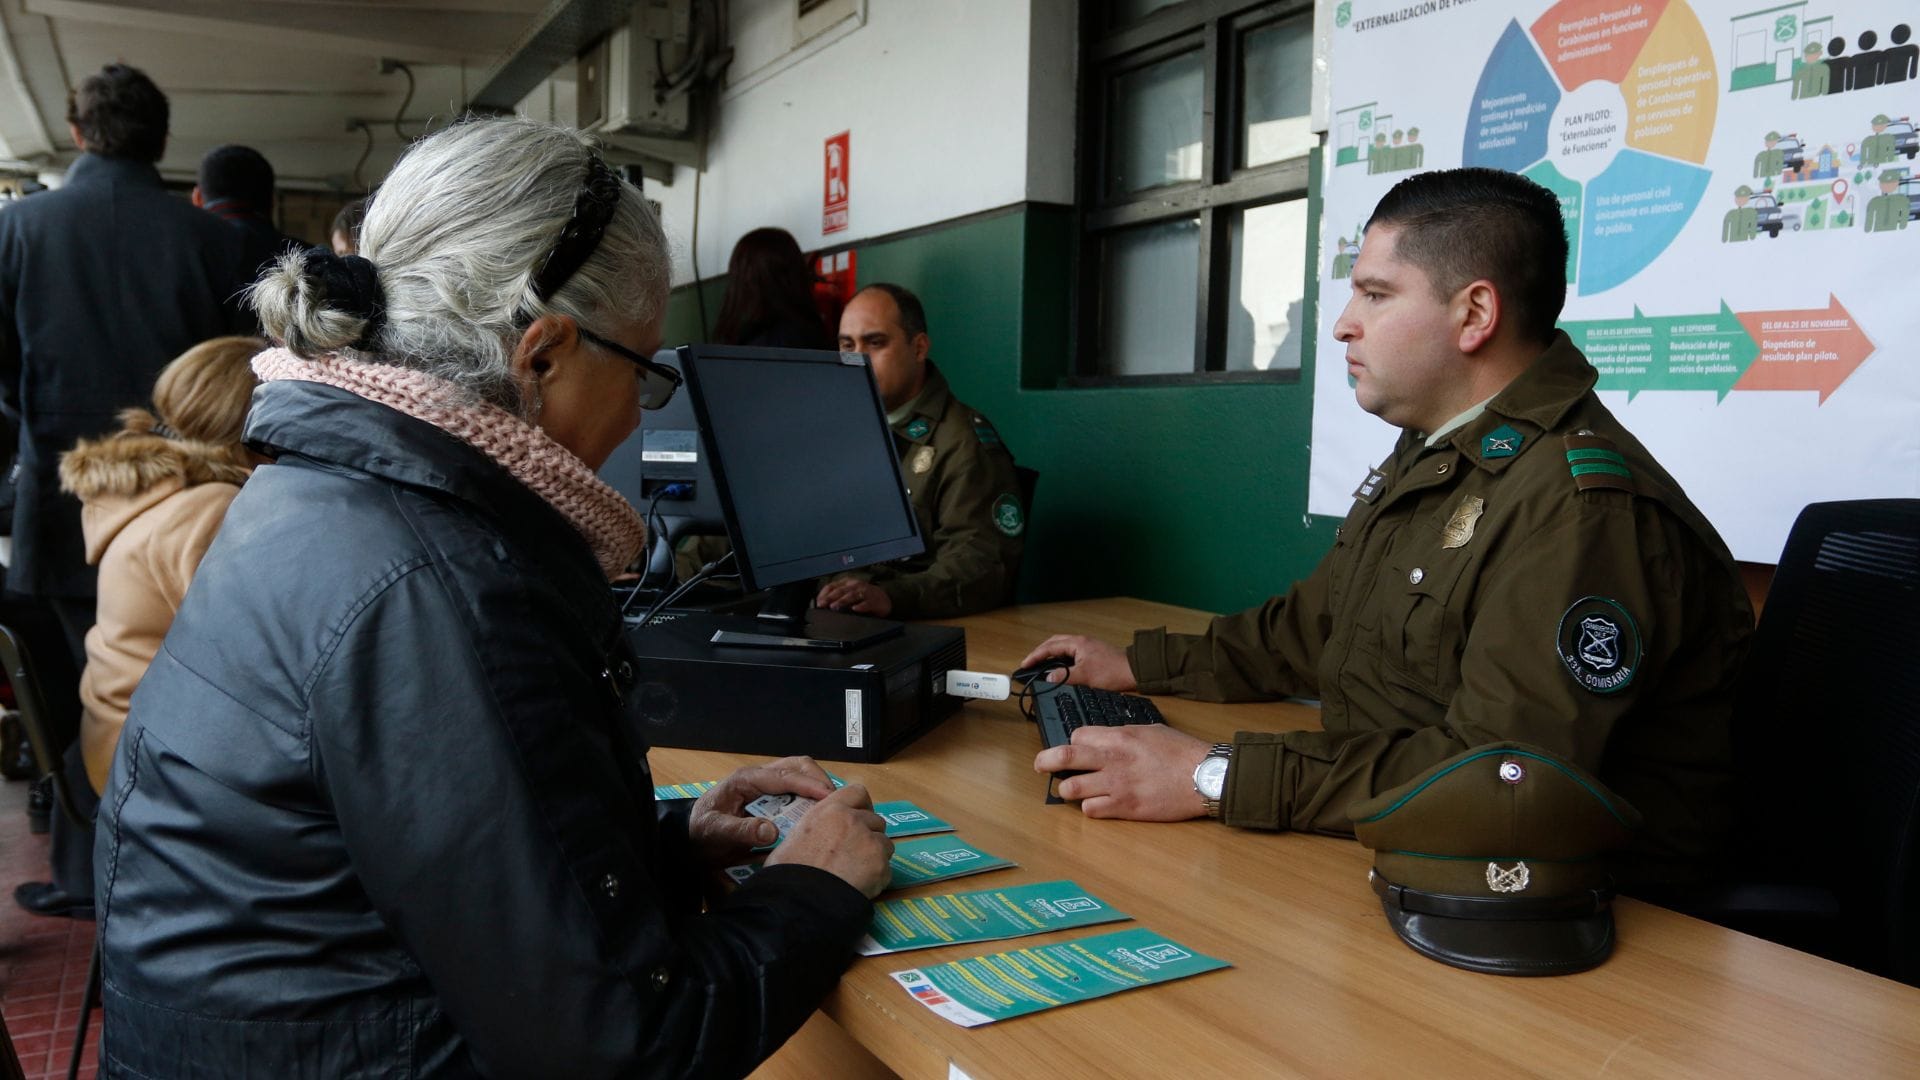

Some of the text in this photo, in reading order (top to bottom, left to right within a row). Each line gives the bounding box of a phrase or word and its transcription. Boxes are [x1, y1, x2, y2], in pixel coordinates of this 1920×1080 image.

[1558, 3, 1642, 33] Reemplazo Personal de
[1558, 18, 1648, 48] Carabineros en funciones
[1688, 55, 1699, 67] de
[1637, 70, 1712, 96] personal operativo
[1481, 92, 1527, 111] Mejoramiento
[1636, 89, 1696, 109] de Carabineros
[1647, 108, 1681, 121] servicios
[1682, 103, 1694, 115] de
[1564, 114, 1583, 126] PLAN
[1480, 126, 1489, 137] de
[1561, 146, 1571, 156] de
[1611, 193, 1620, 204] de
[1622, 189, 1654, 206] personal
[1655, 186, 1672, 199] civil
[1639, 205, 1649, 217] en
[1594, 225, 1604, 237] de
[1762, 321, 1772, 330] DEL
[1801, 319, 1809, 329] DE
[1810, 318, 1849, 329] NOVIEMBRE
[1618, 343, 1628, 352] del
[1629, 342, 1651, 352] servicio
[1707, 340, 1718, 350] del
[1762, 338, 1817, 352] Diagnóstico de
[1593, 354, 1615, 366] guardia
[1616, 353, 1626, 363] del
[1626, 351, 1652, 366] personal
[1669, 351, 1730, 364] sonal de guardia en
[1762, 351, 1795, 362] resultado
[1796, 351, 1813, 363] plan
[1669, 364, 1695, 374] servicios
[1695, 364, 1704, 373] de
[1585, 665, 1632, 688] COMISARIA
